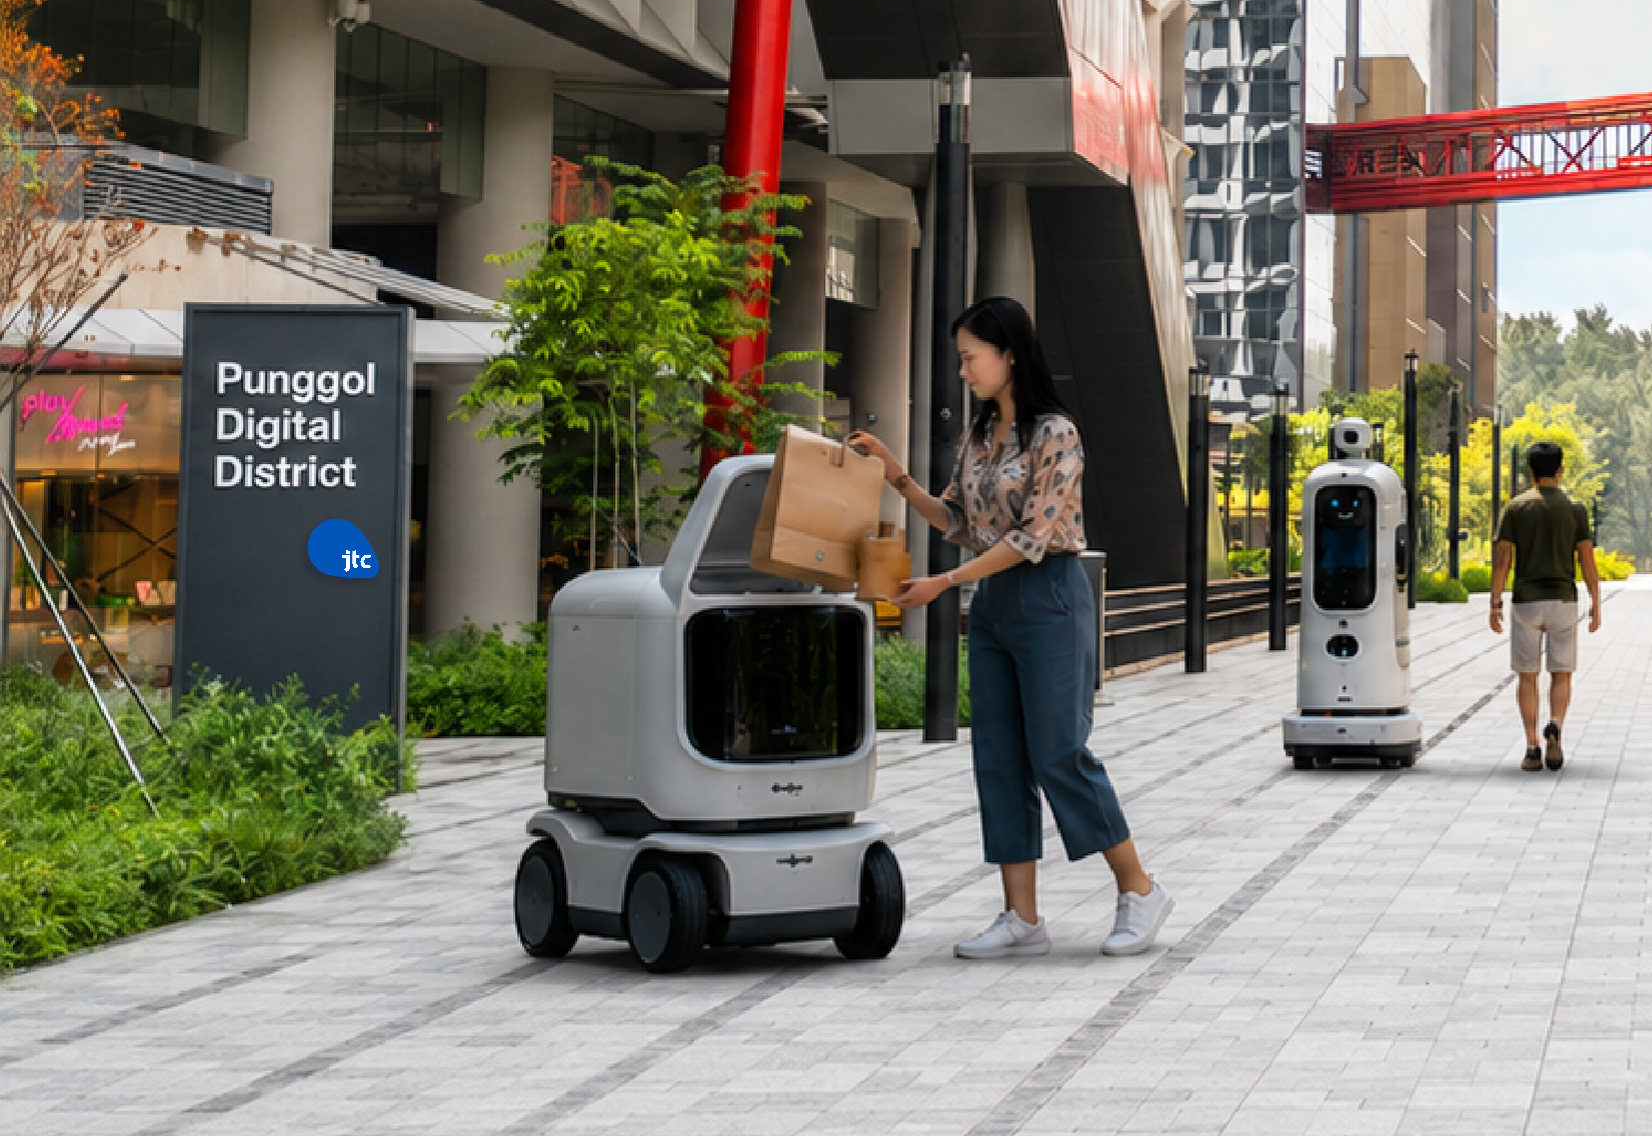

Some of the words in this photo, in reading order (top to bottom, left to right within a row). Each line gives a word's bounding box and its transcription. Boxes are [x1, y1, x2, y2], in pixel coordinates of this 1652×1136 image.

[217, 361, 375, 404] Punggol
[216, 407, 341, 449] Digital
[215, 454, 357, 488] District
[341, 549, 372, 573] jtc
